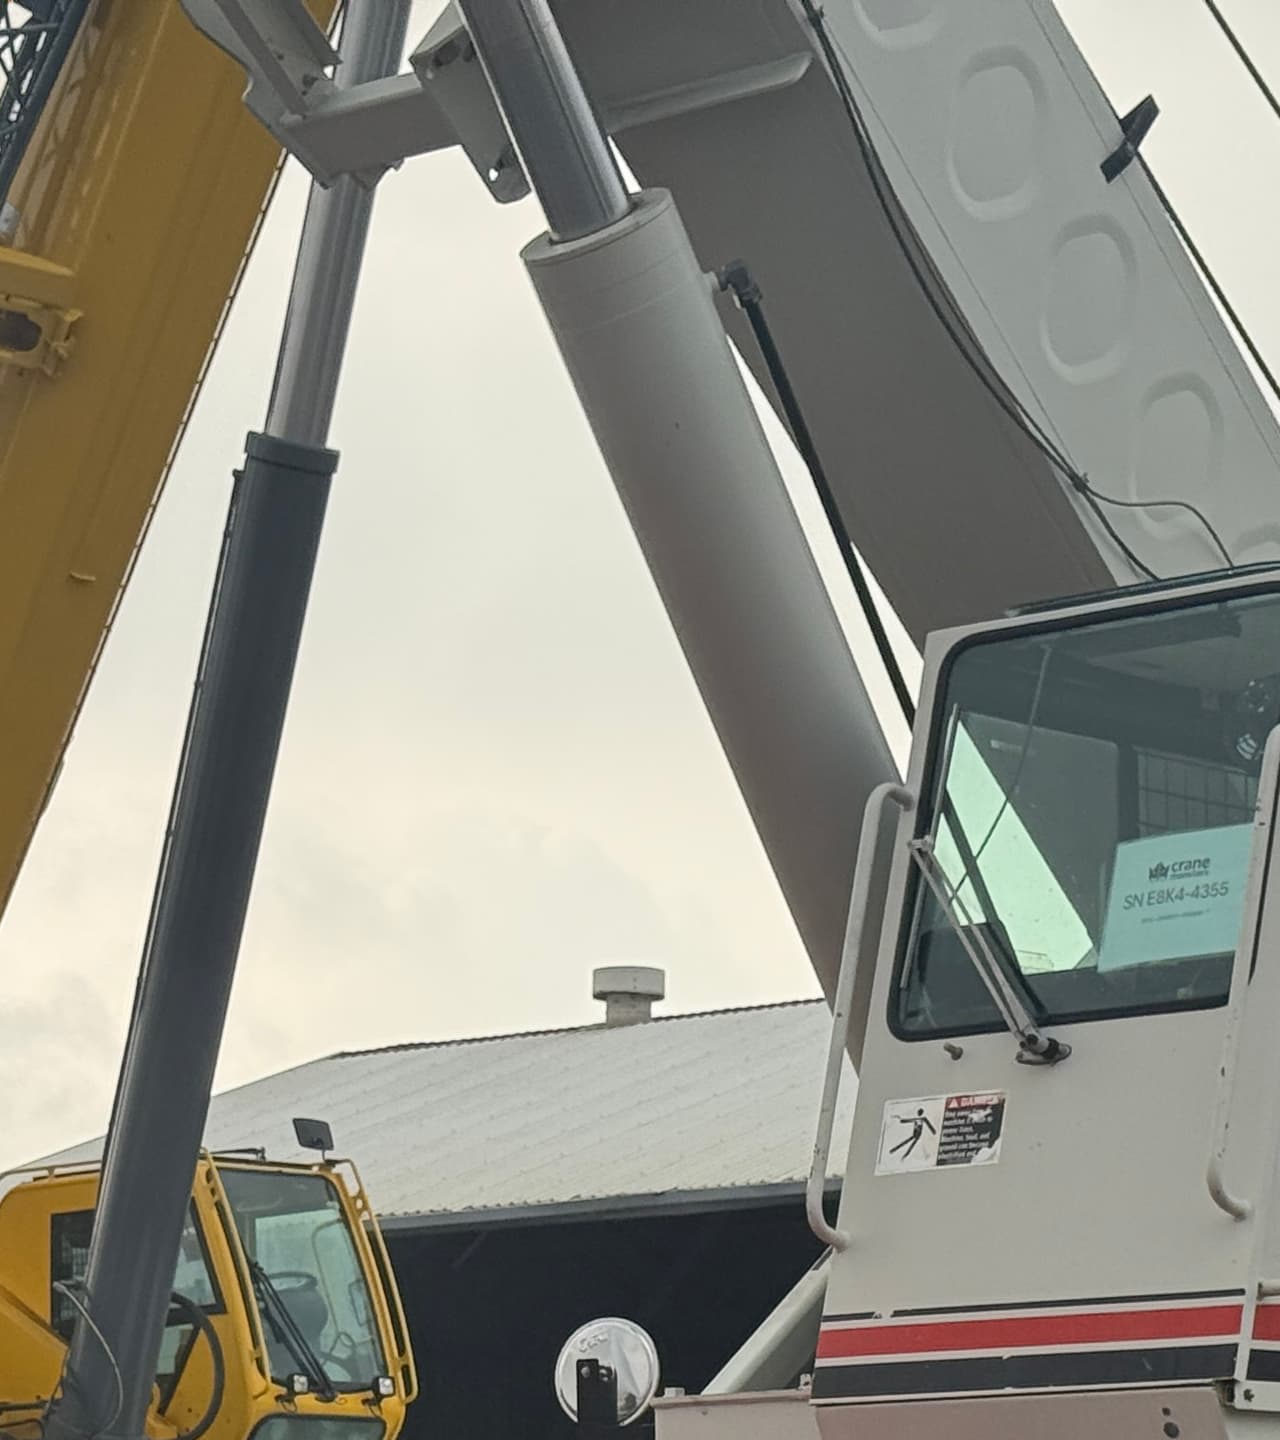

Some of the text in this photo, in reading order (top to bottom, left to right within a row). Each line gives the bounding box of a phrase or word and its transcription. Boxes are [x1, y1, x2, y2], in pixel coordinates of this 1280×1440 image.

[1171, 858, 1211, 873] crane
[1123, 881, 1229, 910] SN E8K4-4355
